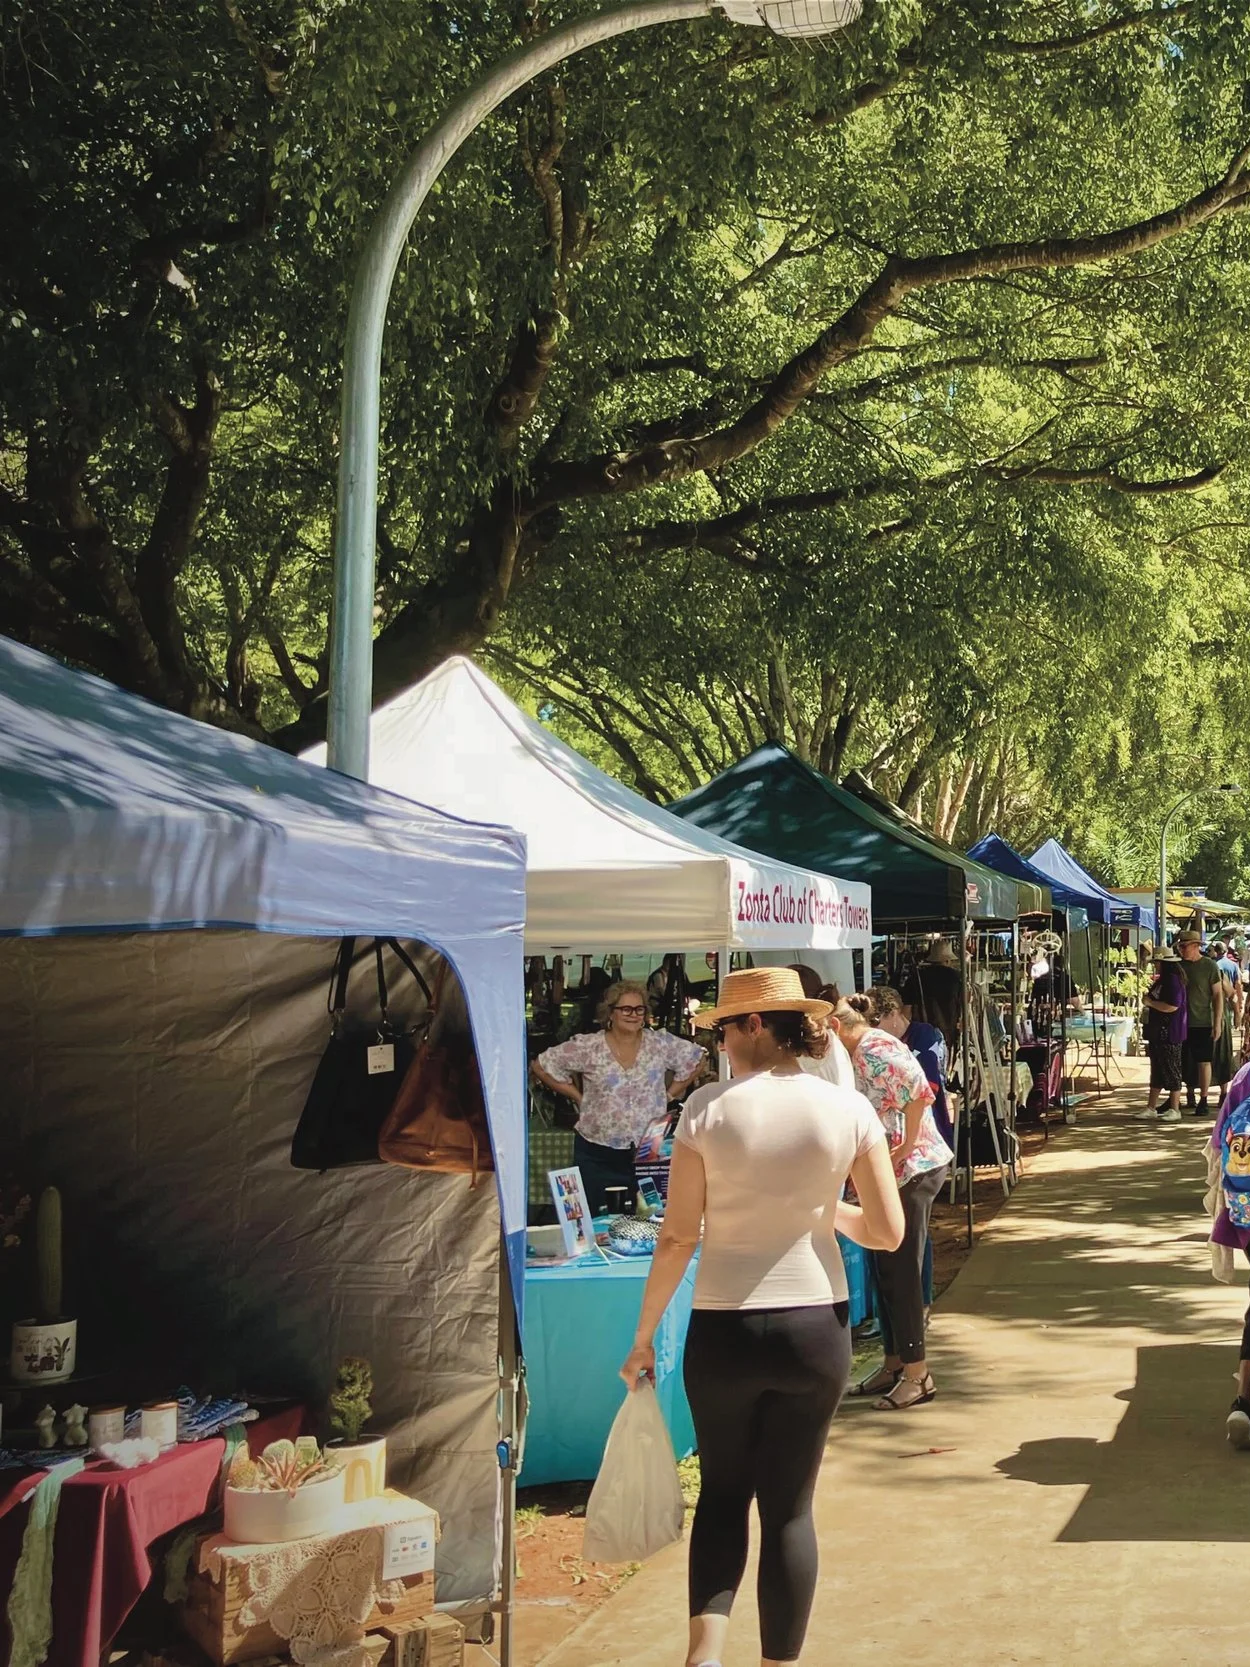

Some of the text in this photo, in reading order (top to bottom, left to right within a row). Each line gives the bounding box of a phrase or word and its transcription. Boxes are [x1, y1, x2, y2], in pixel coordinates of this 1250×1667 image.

[737, 881, 869, 931] Zonta Club of Charters Towers
